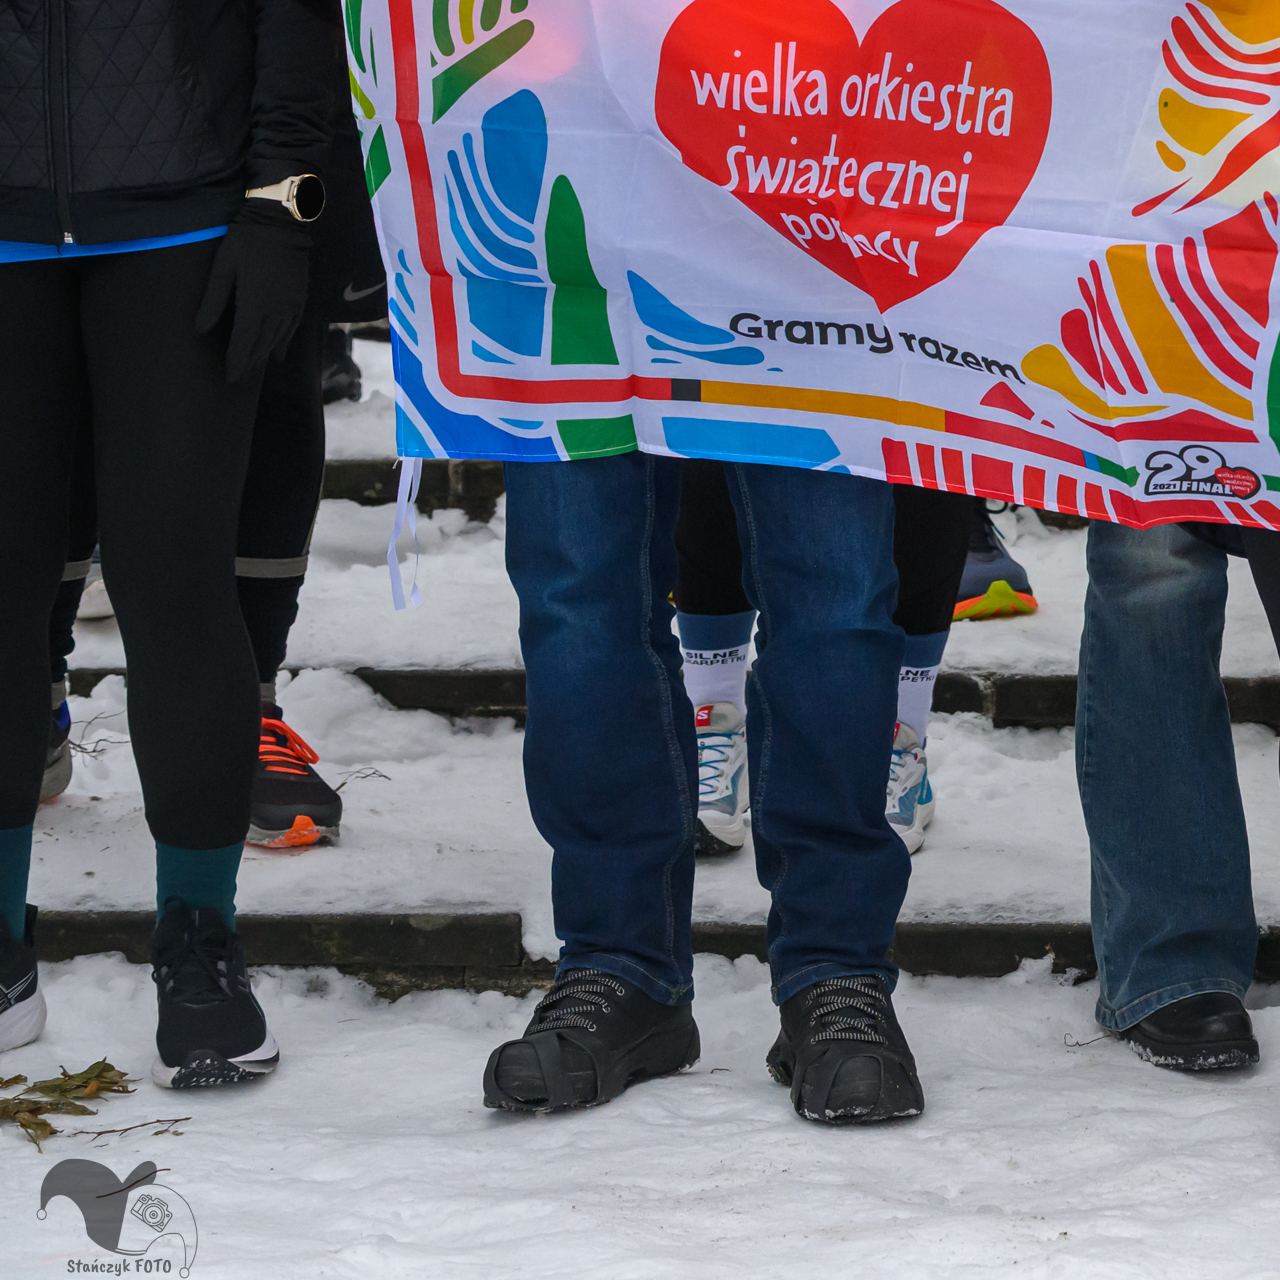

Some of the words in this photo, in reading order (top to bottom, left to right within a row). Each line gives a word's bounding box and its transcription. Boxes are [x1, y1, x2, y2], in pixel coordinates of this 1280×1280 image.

[690, 41, 829, 118] wielka
[840, 51, 1015, 137] orkiestra
[719, 124, 974, 237] świątecznej
[780, 212, 920, 278] pomocy
[729, 312, 894, 354] Gramy
[898, 330, 1026, 385] razem
[1146, 446, 1226, 492] 29
[1152, 483, 1177, 491] 2021
[685, 649, 739, 660] SILNE
